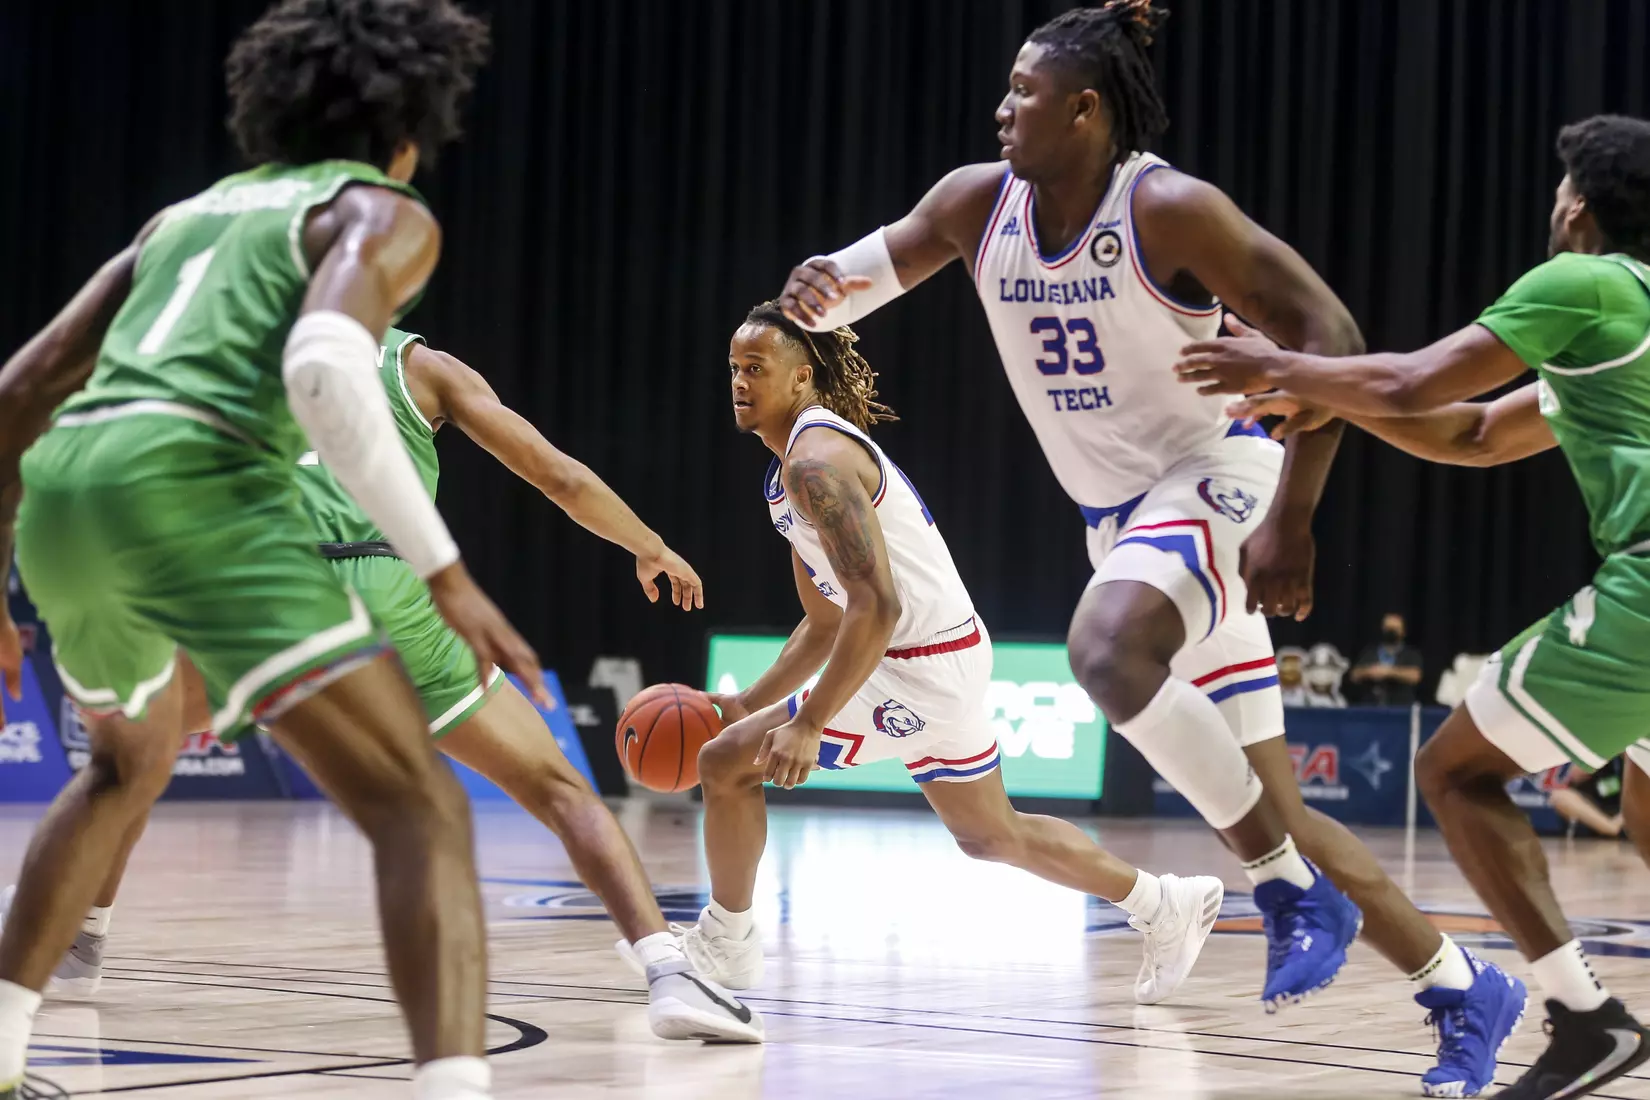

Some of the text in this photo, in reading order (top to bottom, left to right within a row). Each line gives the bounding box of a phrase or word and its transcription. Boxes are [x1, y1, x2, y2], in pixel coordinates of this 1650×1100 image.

[138, 248, 216, 355] 1
[1029, 316, 1106, 376] 33
[1047, 386, 1114, 412] TECH
